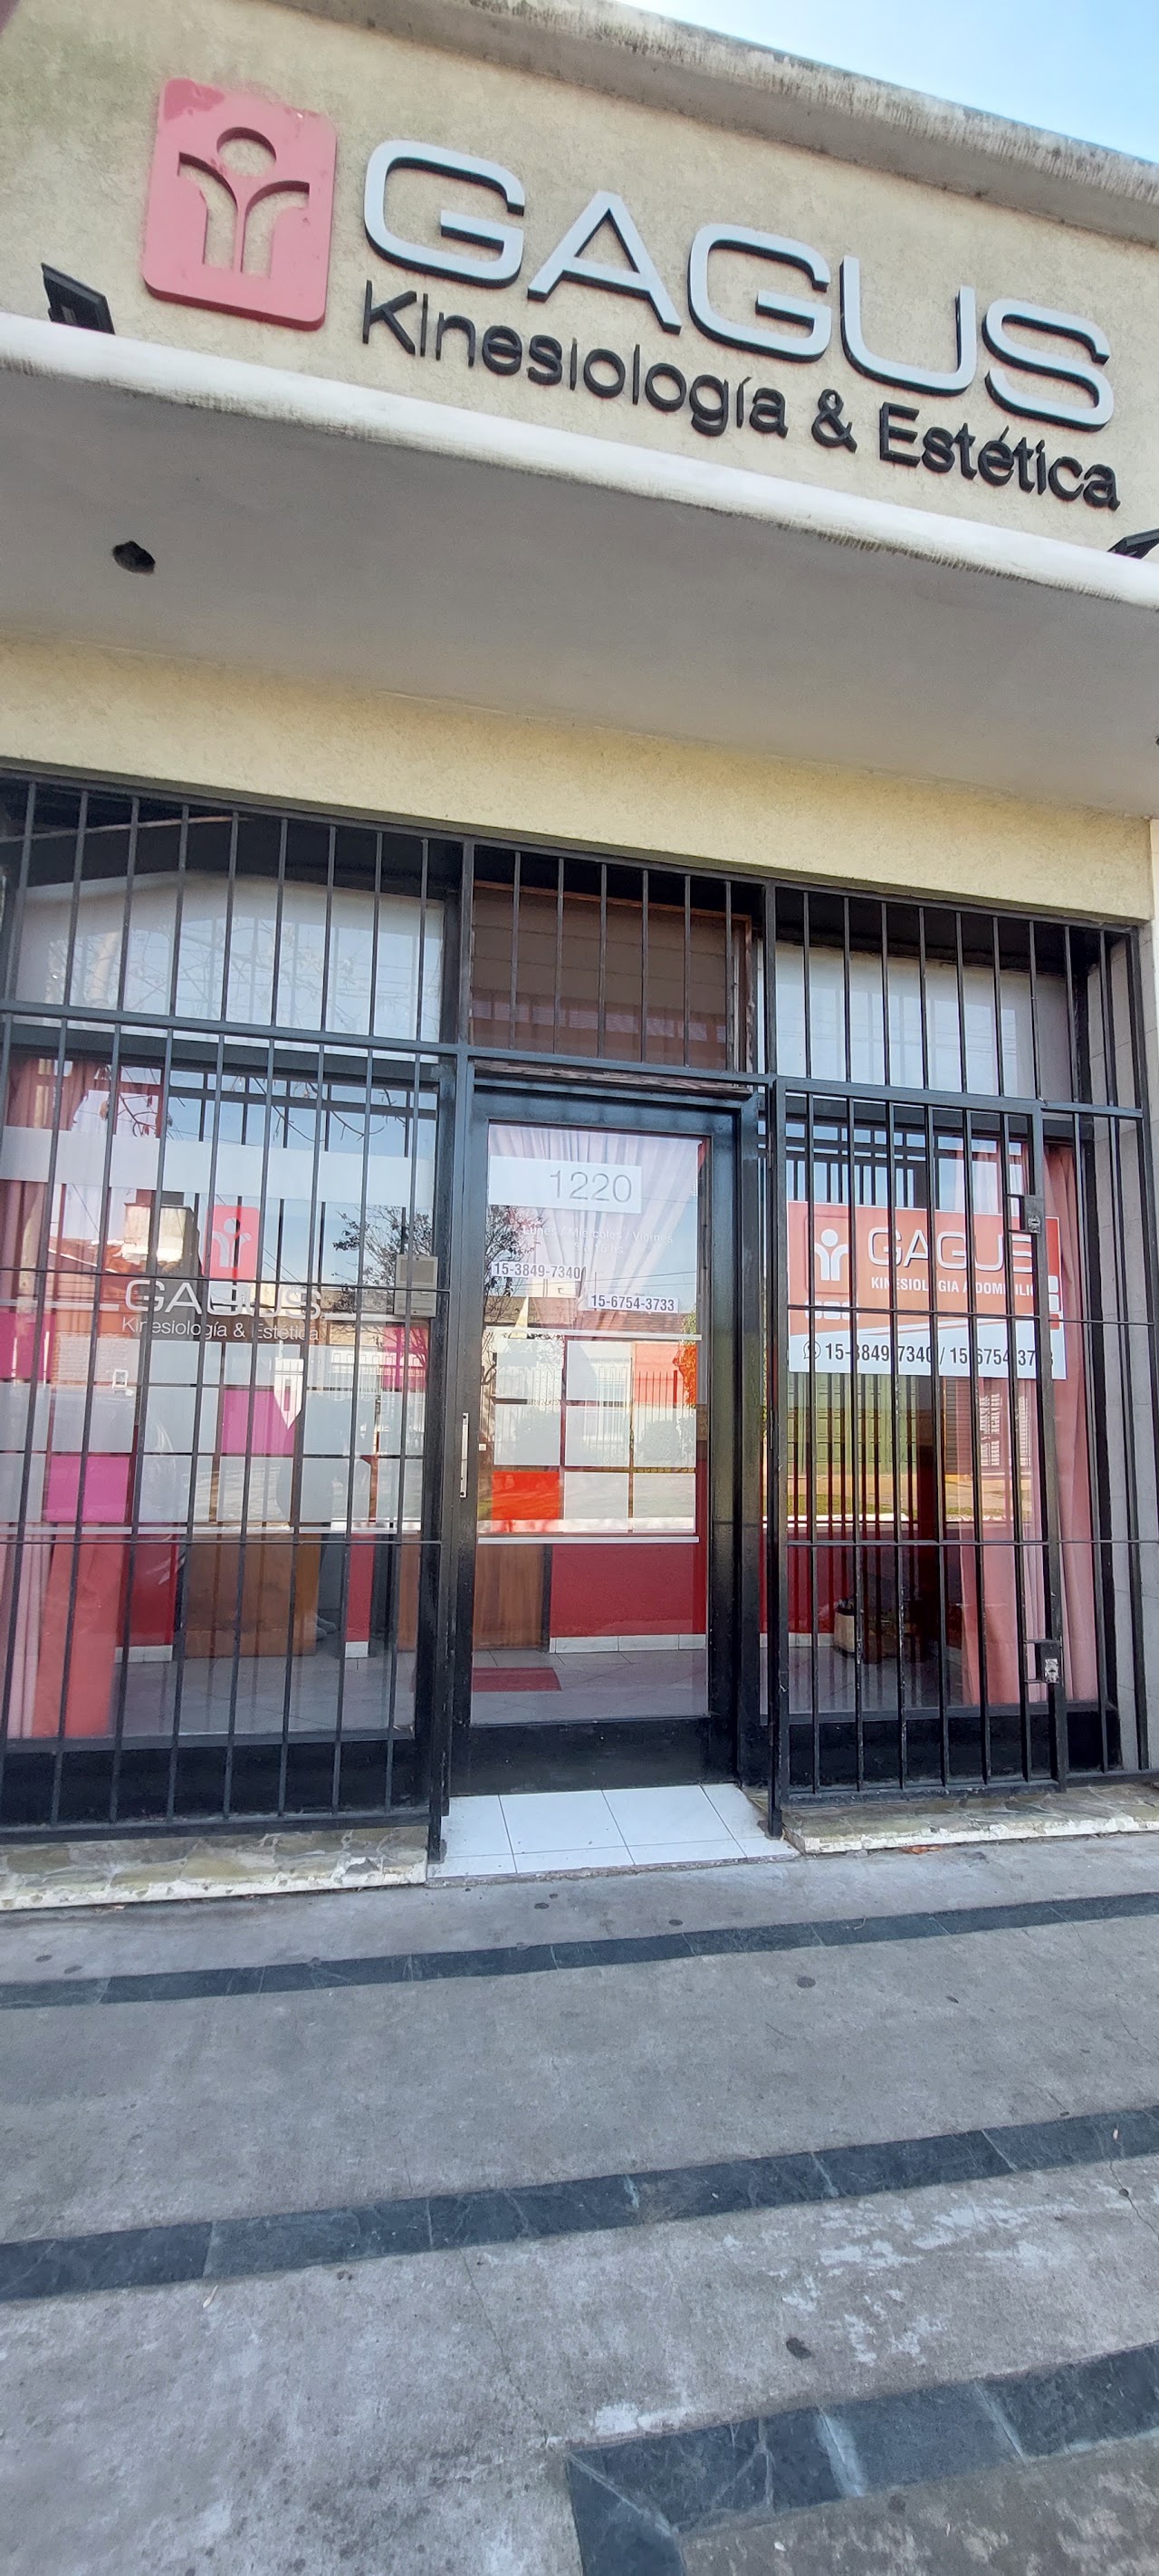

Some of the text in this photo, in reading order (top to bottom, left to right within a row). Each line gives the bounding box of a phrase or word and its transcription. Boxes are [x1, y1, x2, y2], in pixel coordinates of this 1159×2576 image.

[364, 139, 1115, 431] GAGUS
[362, 279, 1121, 512] Kinesiología & Estética
[551, 1169, 633, 1203] 1220
[523, 1223, 558, 1233] Lunes
[633, 1230, 674, 1244] Viernes
[493, 1262, 580, 1281] 15-3849-7340
[871, 1276, 960, 1293] KINESIOLGIA
[591, 1293, 675, 1311] 15-6754-3733
[233, 1322, 246, 1338] &
[939, 1346, 945, 1366] /
